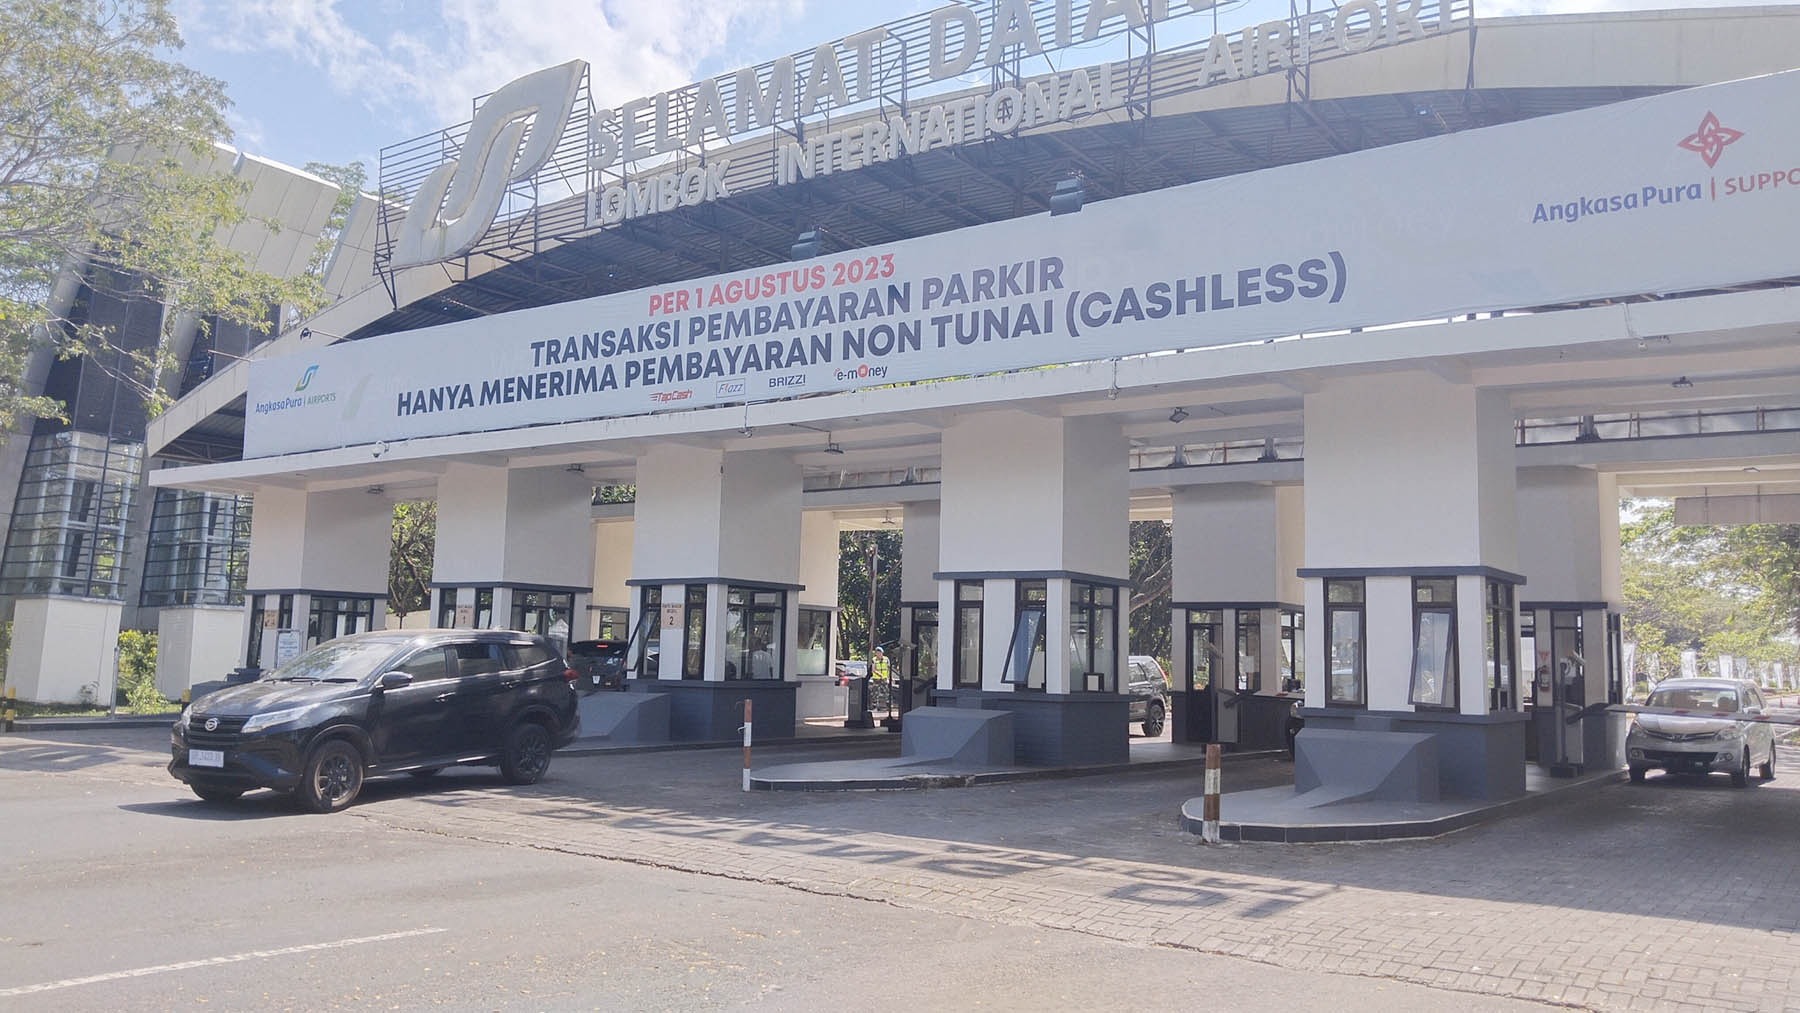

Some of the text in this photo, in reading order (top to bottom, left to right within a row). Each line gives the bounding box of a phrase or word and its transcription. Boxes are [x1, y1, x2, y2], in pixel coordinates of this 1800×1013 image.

[585, 159, 731, 228] LOMBOK
[777, 63, 1126, 186] INTERNATIONAL
[588, 27, 887, 170] SELAMAT
[397, 250, 1347, 416] HANYA MENERIMA PEMBAYARAN NON TUNAI (CASHLESS)
[530, 257, 1064, 367] TRANSAKSI PEMBAYARAN PARKIR
[649, 253, 895, 316] PER 1 AGUSTUS 2023
[307, 392, 337, 406] AIRPORTS
[769, 374, 806, 387] BRIZZI
